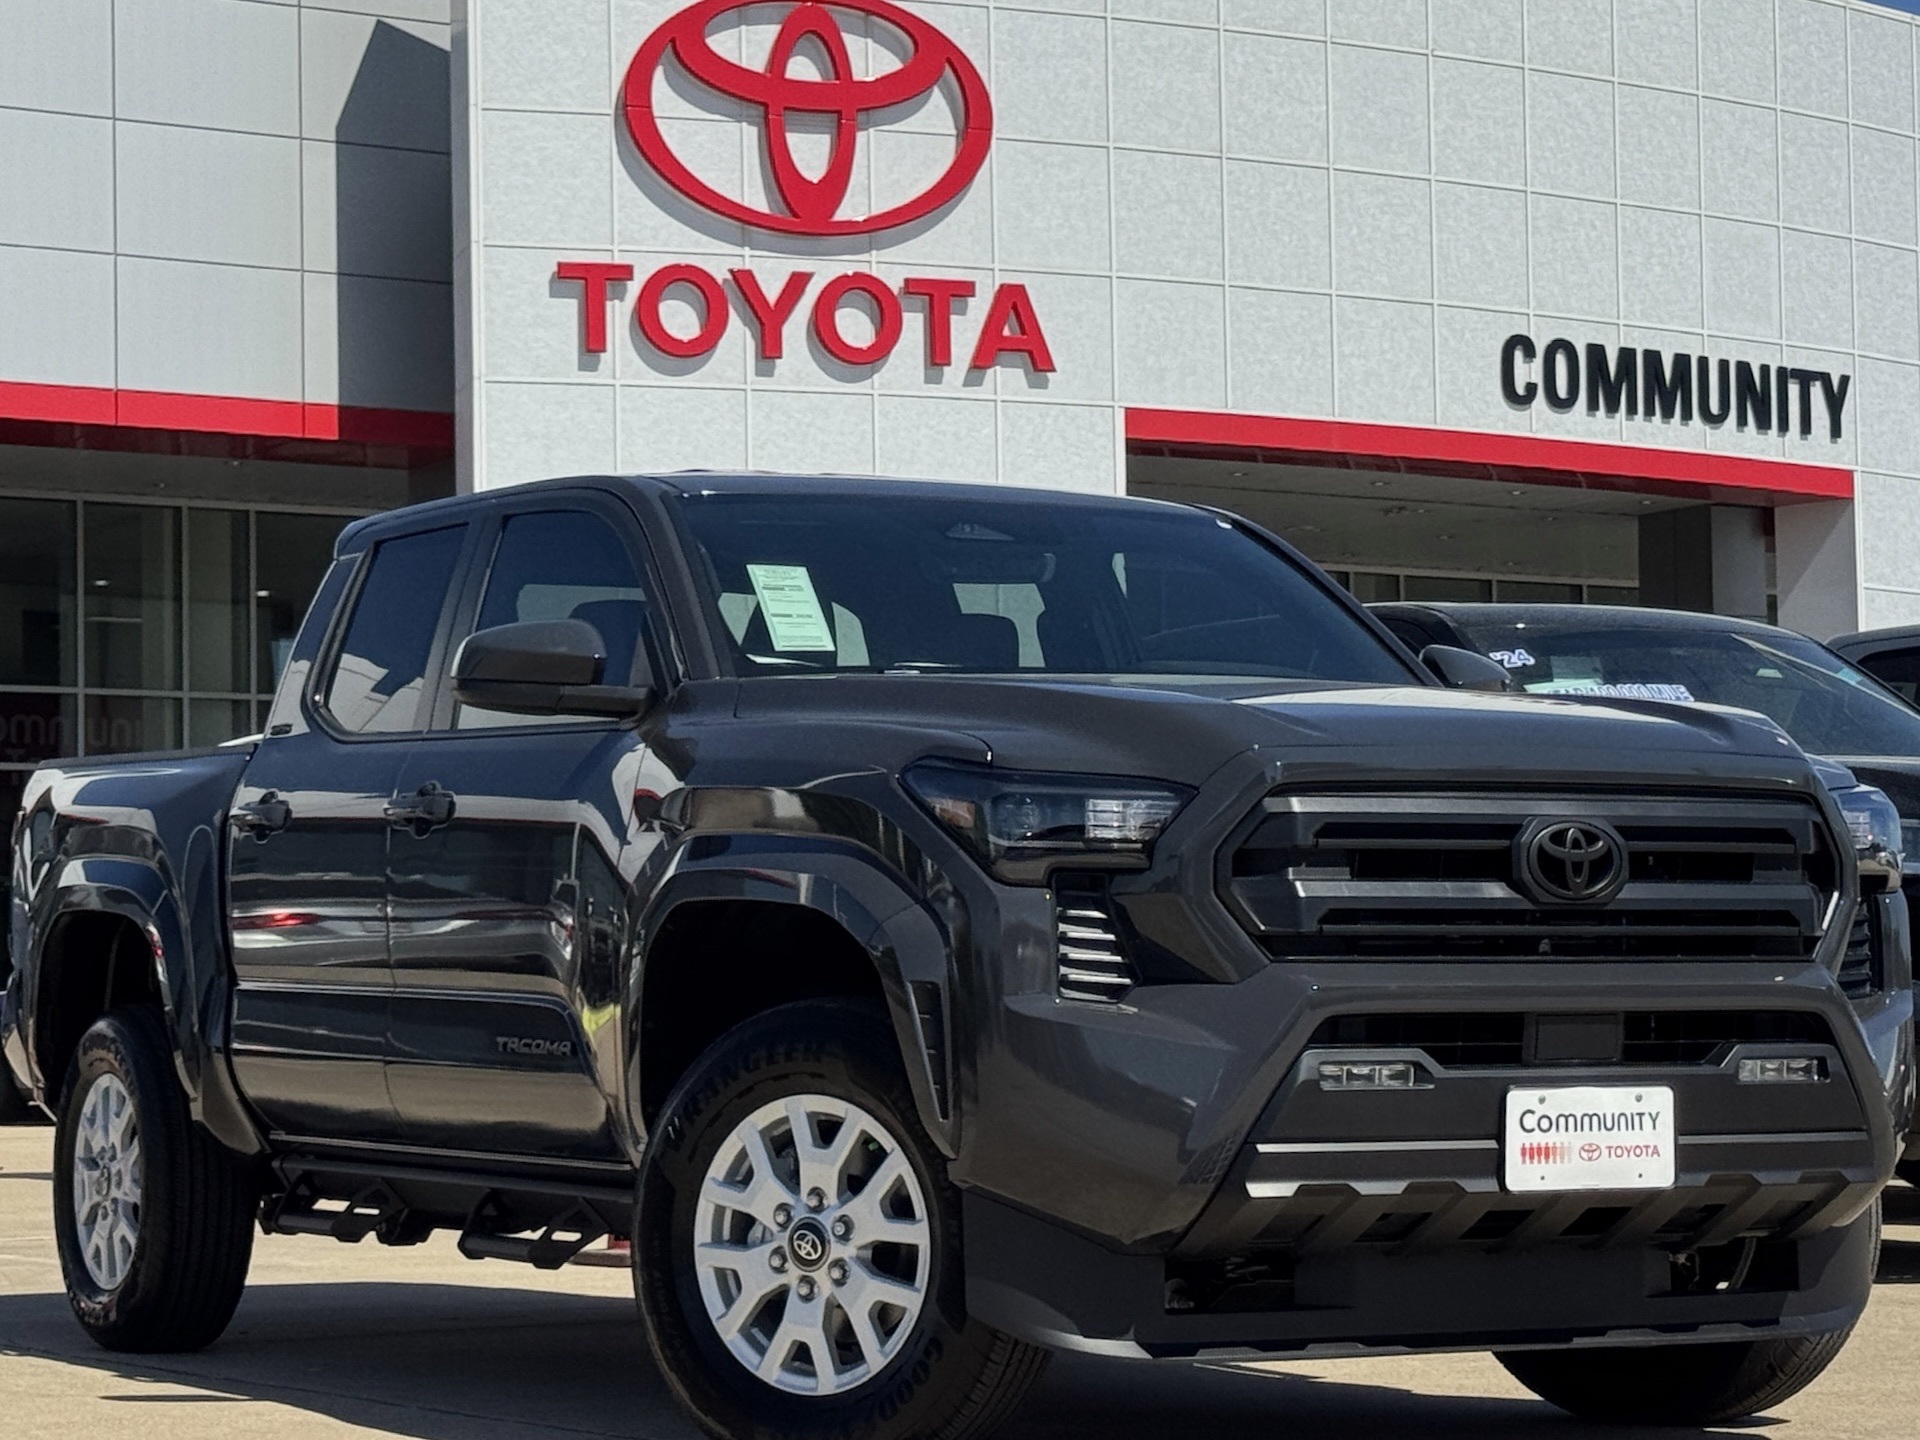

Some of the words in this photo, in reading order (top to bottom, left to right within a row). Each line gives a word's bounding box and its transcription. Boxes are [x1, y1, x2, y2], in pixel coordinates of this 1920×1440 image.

[556, 261, 1057, 373] TOYOTA
[1501, 334, 1851, 439] COMMUNITY
[496, 1036, 572, 1057] TACOMA
[1605, 1144, 1661, 1160] TOYOTA
